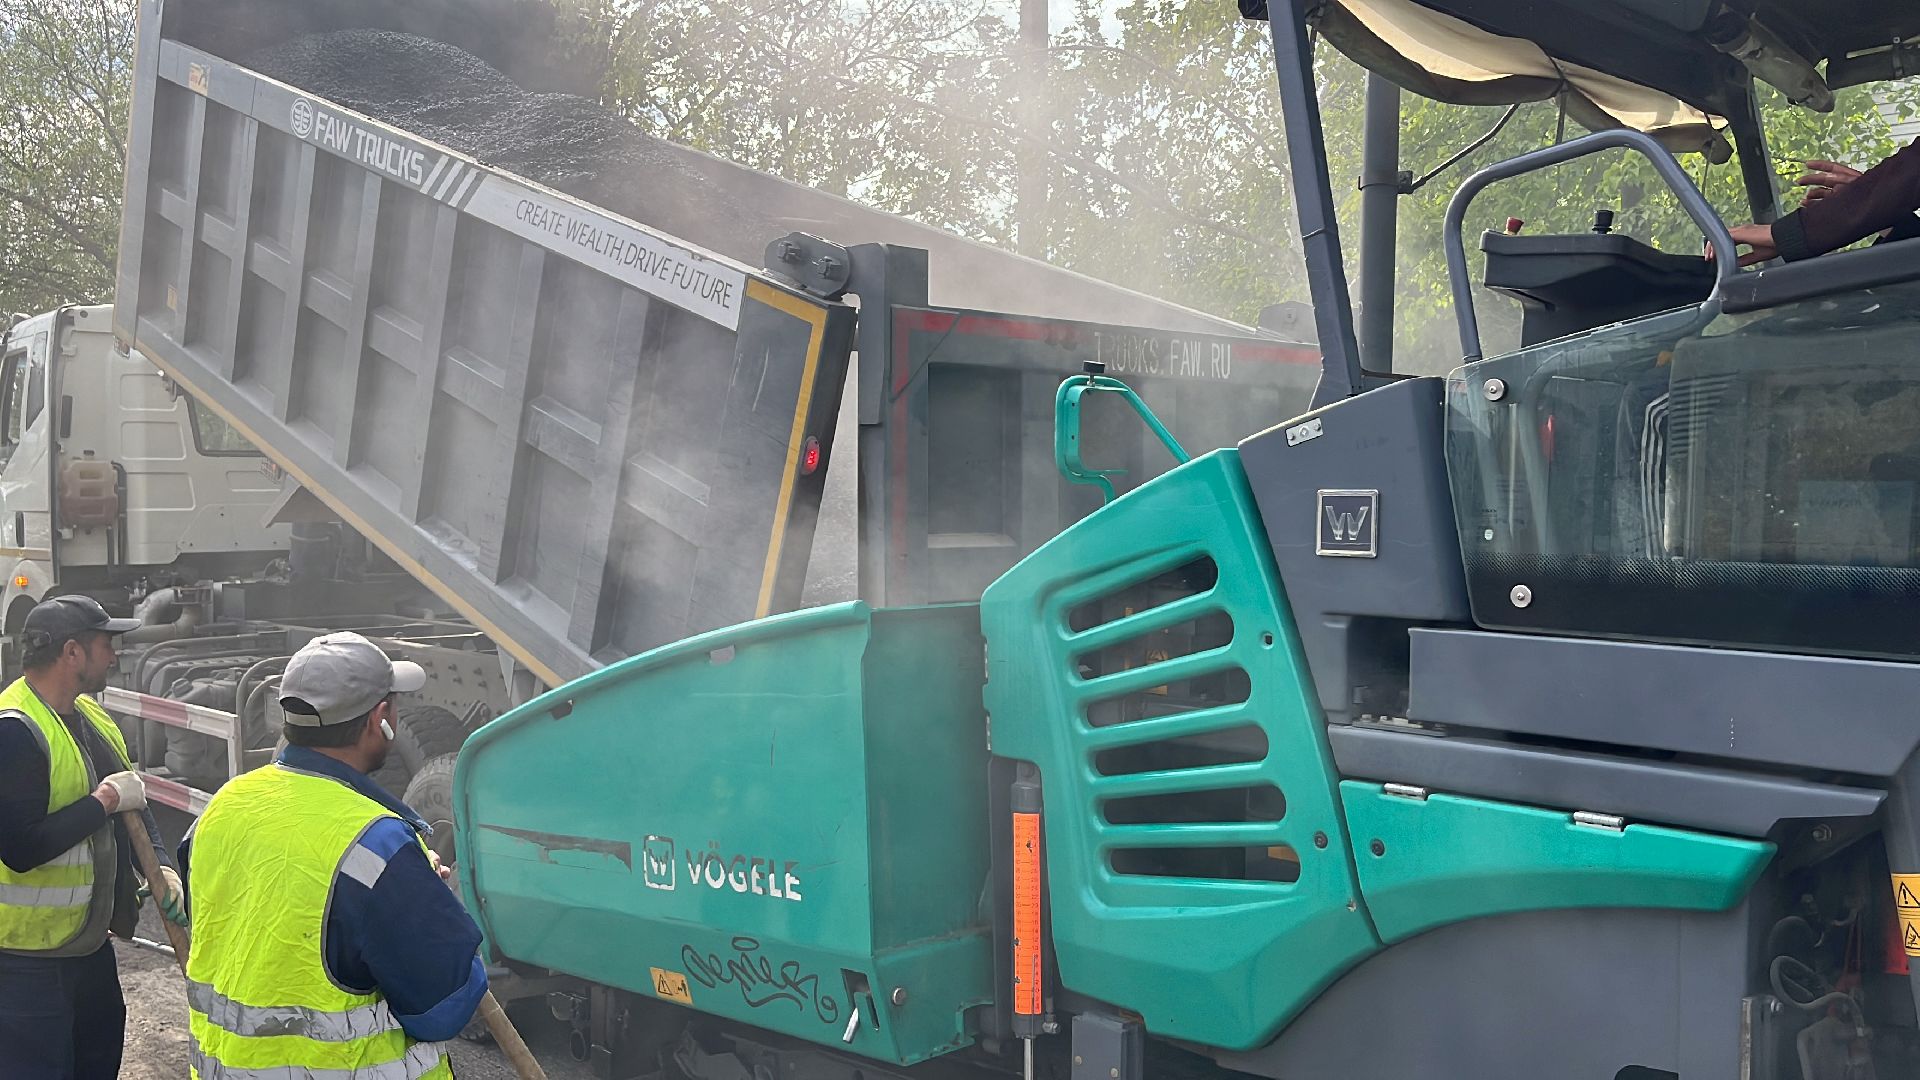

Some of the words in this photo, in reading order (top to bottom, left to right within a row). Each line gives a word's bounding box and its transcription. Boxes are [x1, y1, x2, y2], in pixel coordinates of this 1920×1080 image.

[314, 111, 354, 153] FAW
[355, 127, 425, 186] TRUCKS
[516, 199, 566, 237] CREATE
[670, 261, 733, 309] FUTURE
[686, 840, 802, 902] VÖGELE
